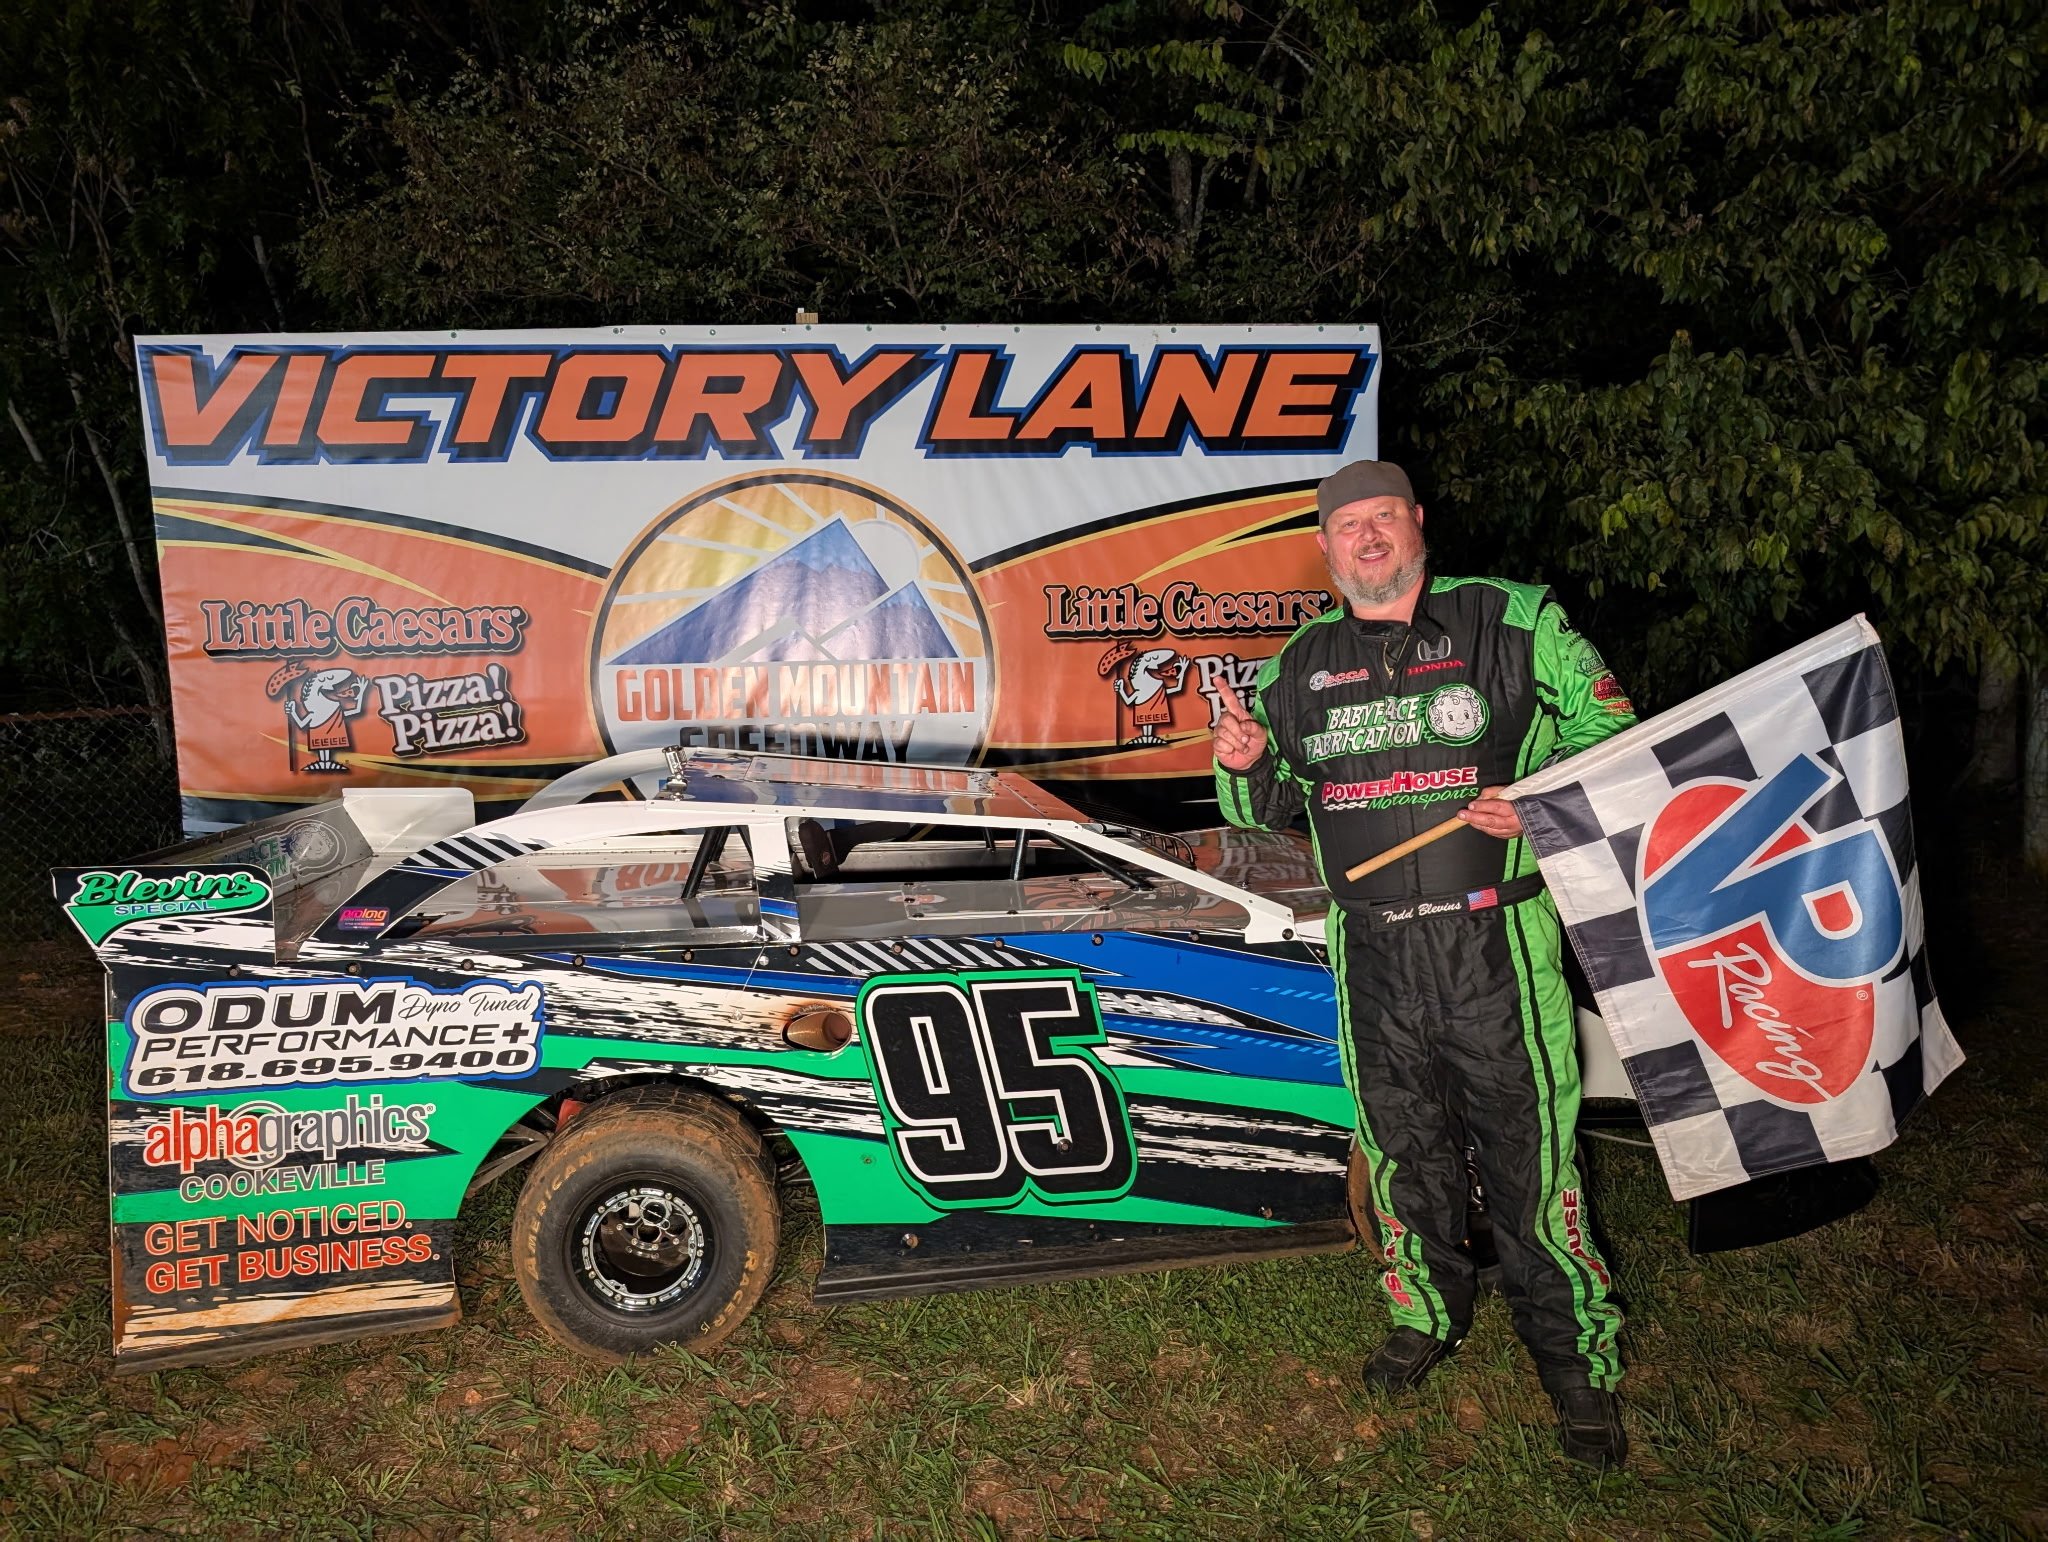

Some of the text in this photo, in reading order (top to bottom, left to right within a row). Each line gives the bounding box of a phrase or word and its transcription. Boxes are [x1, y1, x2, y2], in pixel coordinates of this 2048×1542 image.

[144, 346, 1374, 462] VICTORY LANE
[201, 596, 515, 652] Little Caesars
[1046, 585, 1158, 632] Little
[375, 663, 504, 715] Pizza!
[1407, 660, 1466, 676] HONDA
[616, 662, 975, 722] GOLDEN MOUNTAIN
[1327, 696, 1420, 731] BABYFACE
[391, 702, 518, 752] Pizza!
[1303, 720, 1423, 764] FABRICATION
[1322, 767, 1478, 803] POWERHOUSE
[1368, 786, 1479, 811] Motorsports
[74, 872, 254, 905] Blevins
[115, 901, 216, 916] SPECIAL
[1382, 902, 1463, 924] Todd Blevins
[141, 989, 534, 1034] ODUM Dyno Tuned
[1687, 942, 1834, 1100] Racing
[137, 1050, 530, 1088] 618.695.9400
[862, 977, 1122, 1190] 95
[144, 1094, 431, 1174] alphagraphics
[180, 1159, 386, 1203] COOKEVILLE
[145, 1200, 413, 1256] GET NOTICED.
[146, 1234, 440, 1294] GET BUSINESS.
